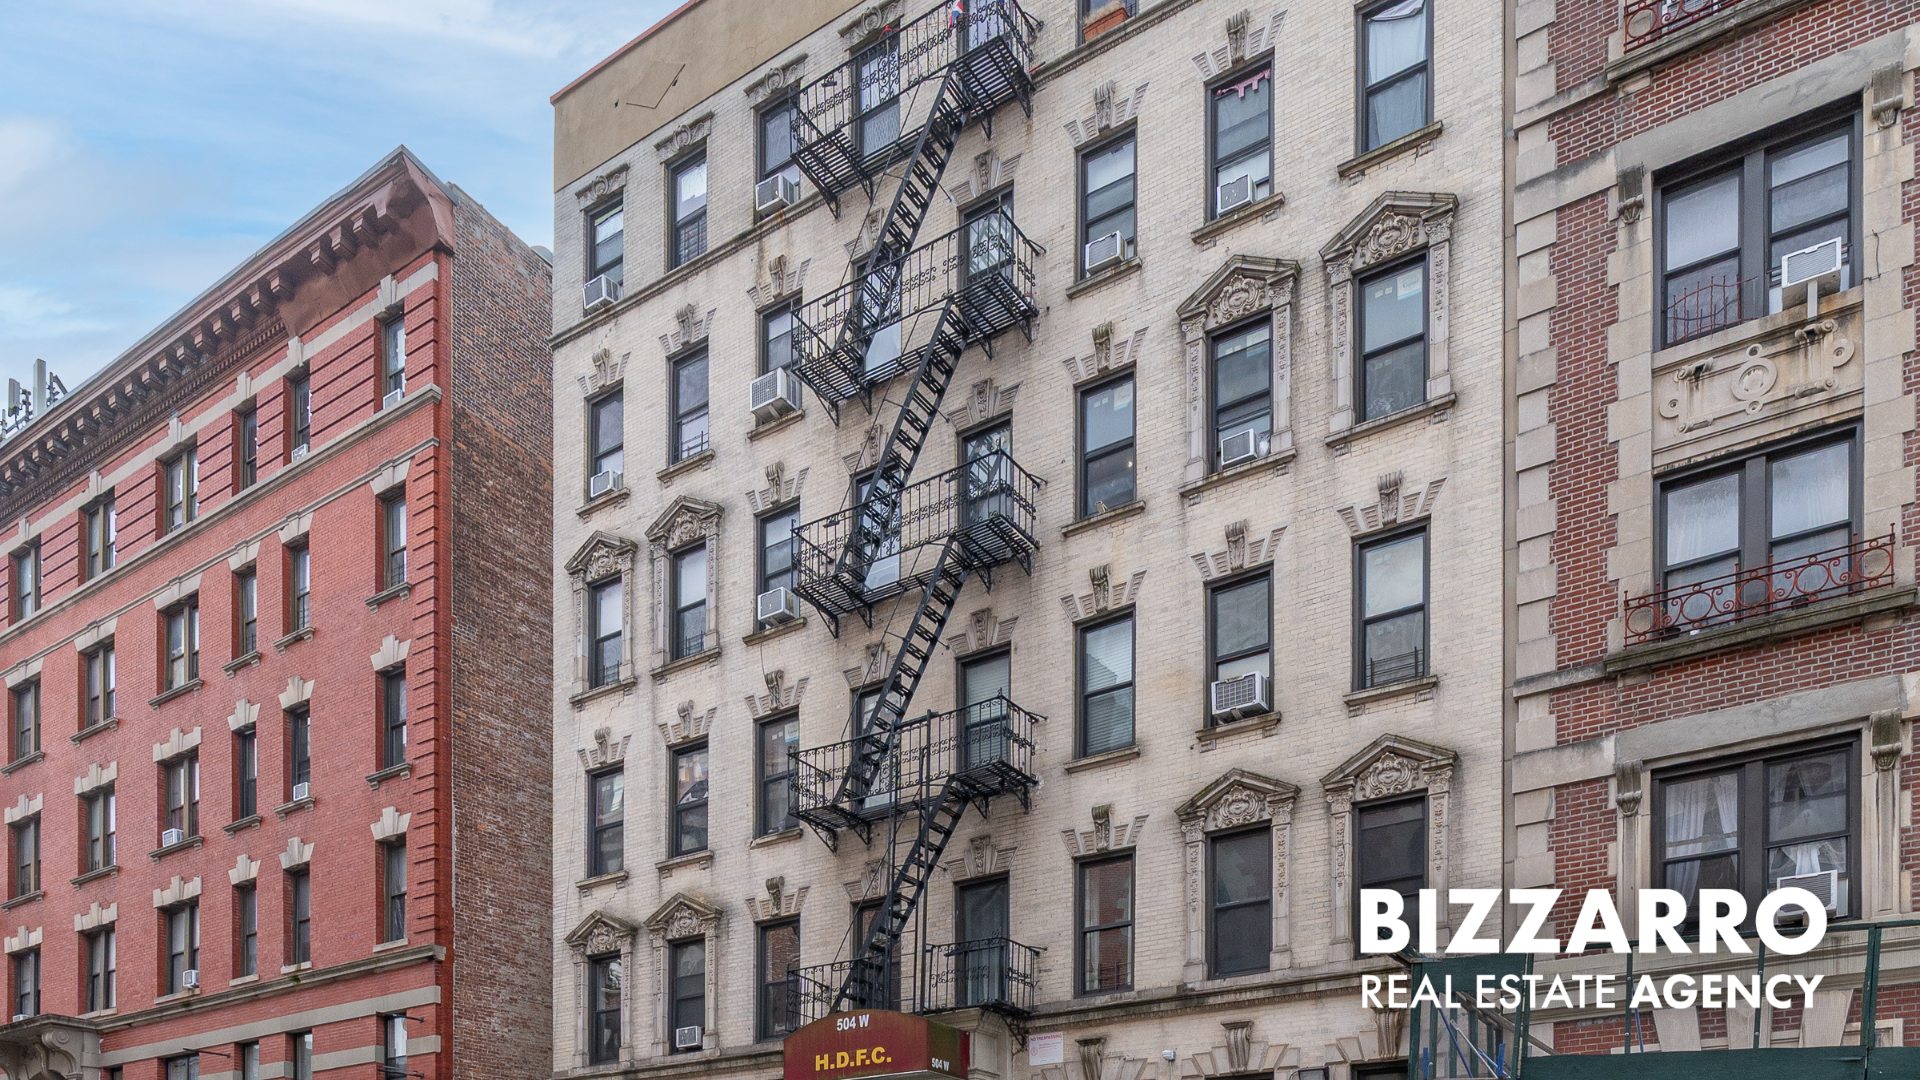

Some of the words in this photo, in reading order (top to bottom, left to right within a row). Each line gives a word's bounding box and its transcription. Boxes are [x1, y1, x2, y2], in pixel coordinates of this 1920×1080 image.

[836, 1016, 856, 1032] 504
[858, 1014, 870, 1028] W
[815, 1046, 892, 1071] H.D.F.C.
[931, 1057, 943, 1069] 504
[943, 1060, 950, 1071] W
